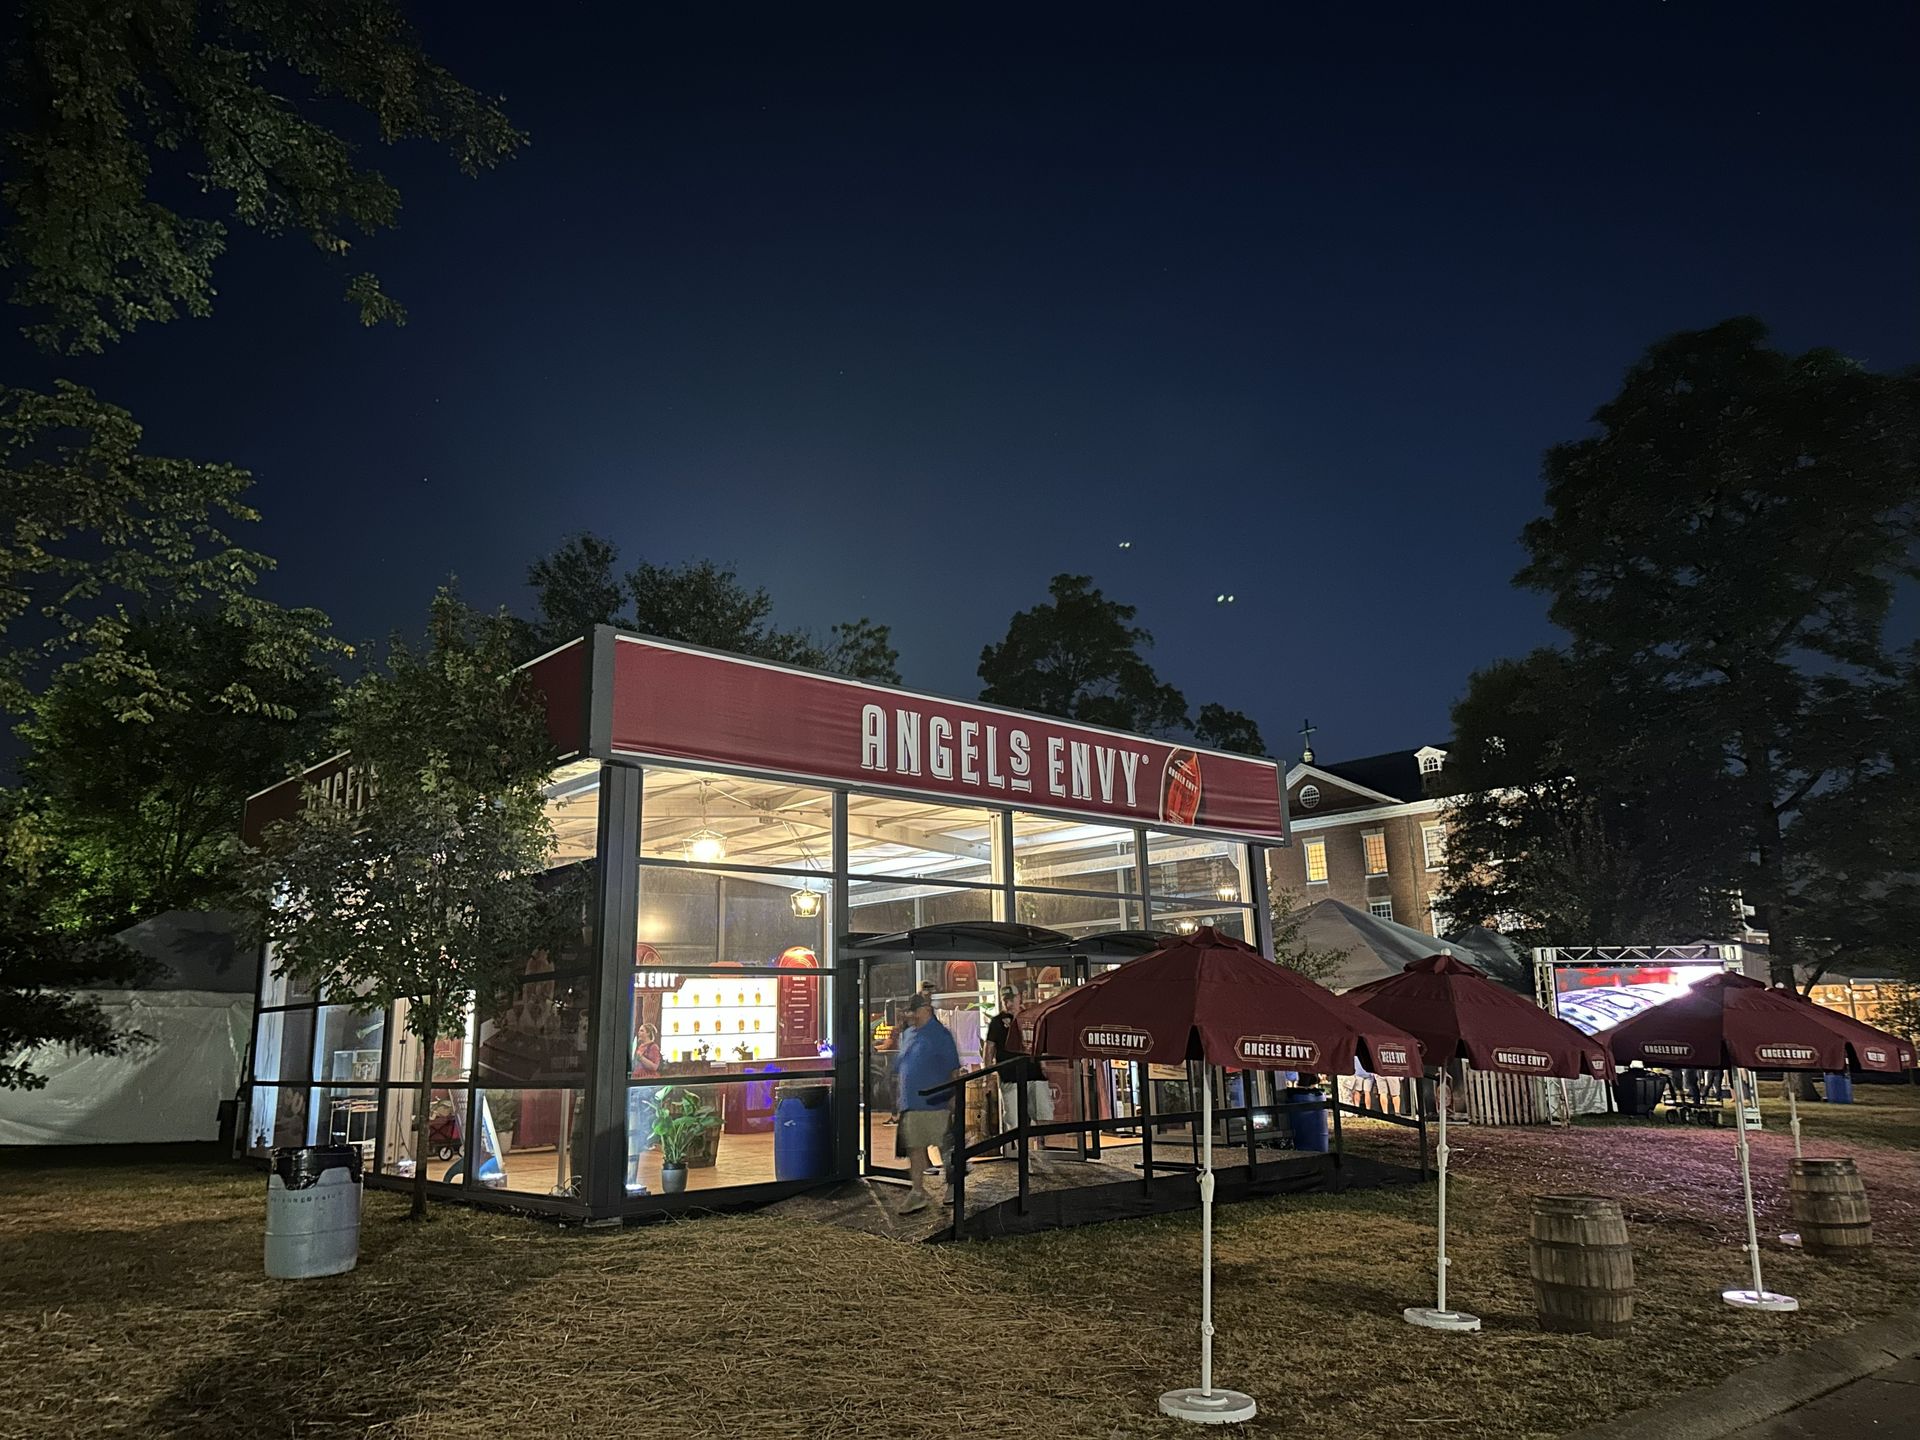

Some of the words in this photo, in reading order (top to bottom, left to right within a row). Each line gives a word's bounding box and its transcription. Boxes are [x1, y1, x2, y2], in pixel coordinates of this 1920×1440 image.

[860, 703, 1032, 793] ANGELS
[1088, 1032, 1120, 1046] ANGELS
[1121, 1034, 1146, 1048] ENVY
[1244, 1042, 1282, 1057] ANGELS
[1285, 1045, 1312, 1059] ENVY
